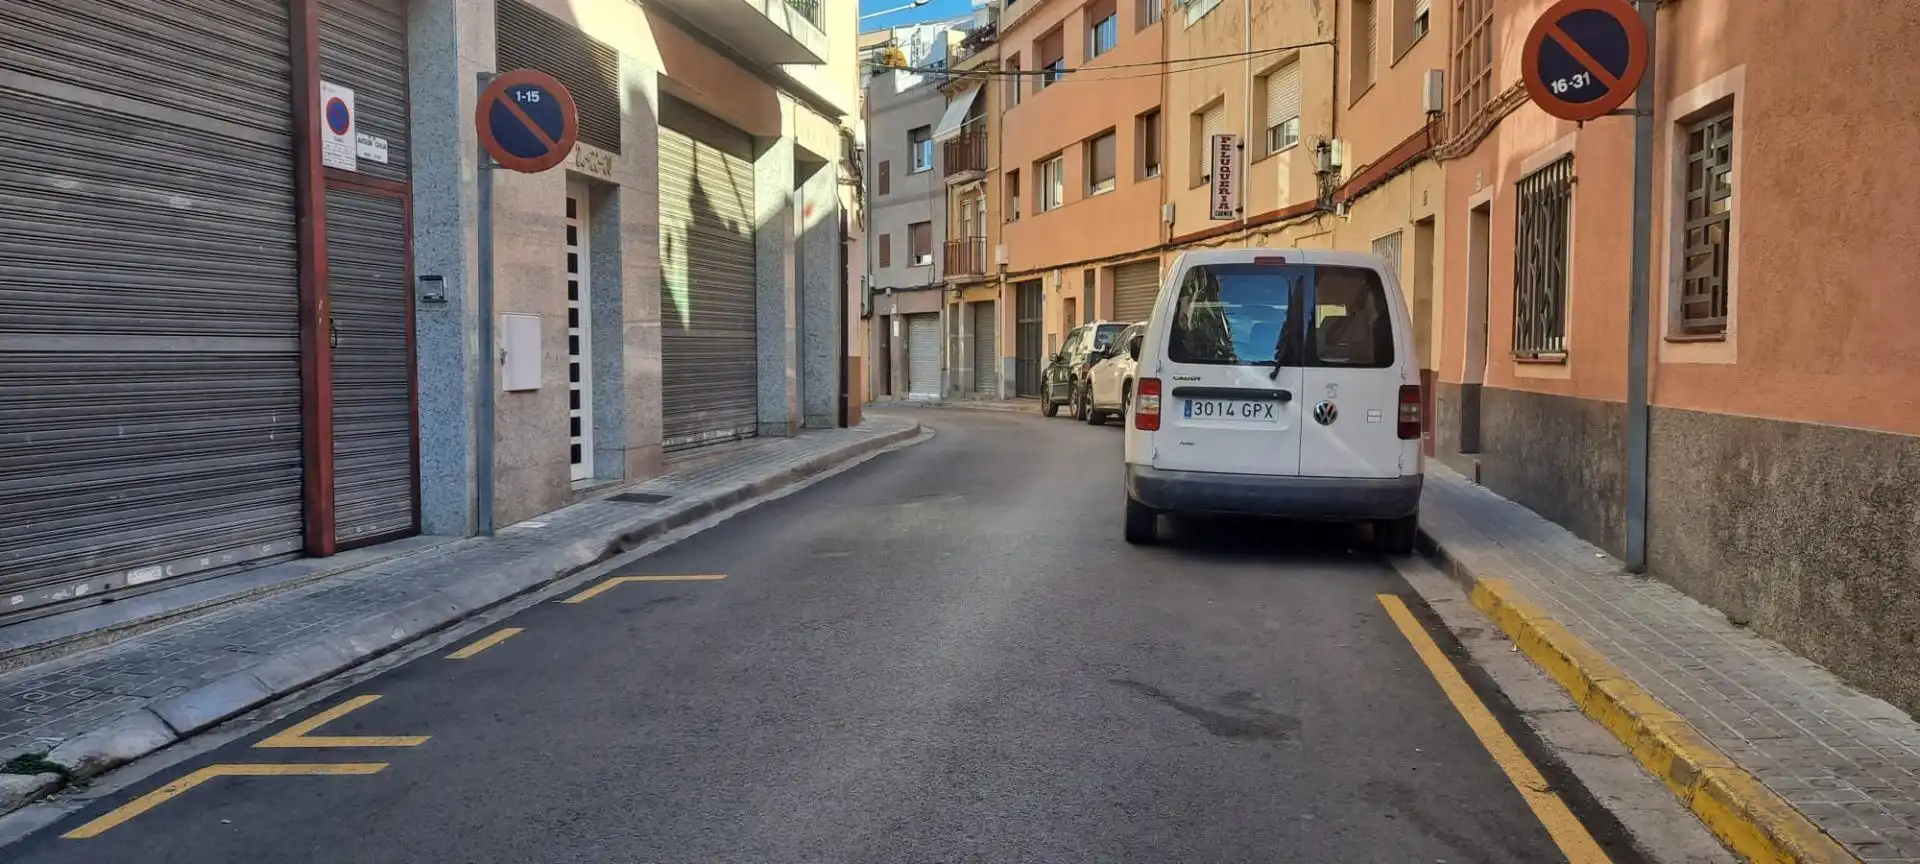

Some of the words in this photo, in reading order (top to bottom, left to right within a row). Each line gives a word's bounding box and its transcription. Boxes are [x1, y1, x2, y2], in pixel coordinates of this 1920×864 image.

[1551, 71, 1590, 94] 16-31
[515, 90, 540, 103] 1-15
[1218, 136, 1232, 210] PELUQUERIA
[1194, 401, 1235, 417] 3014
[1242, 403, 1274, 419] GPX
